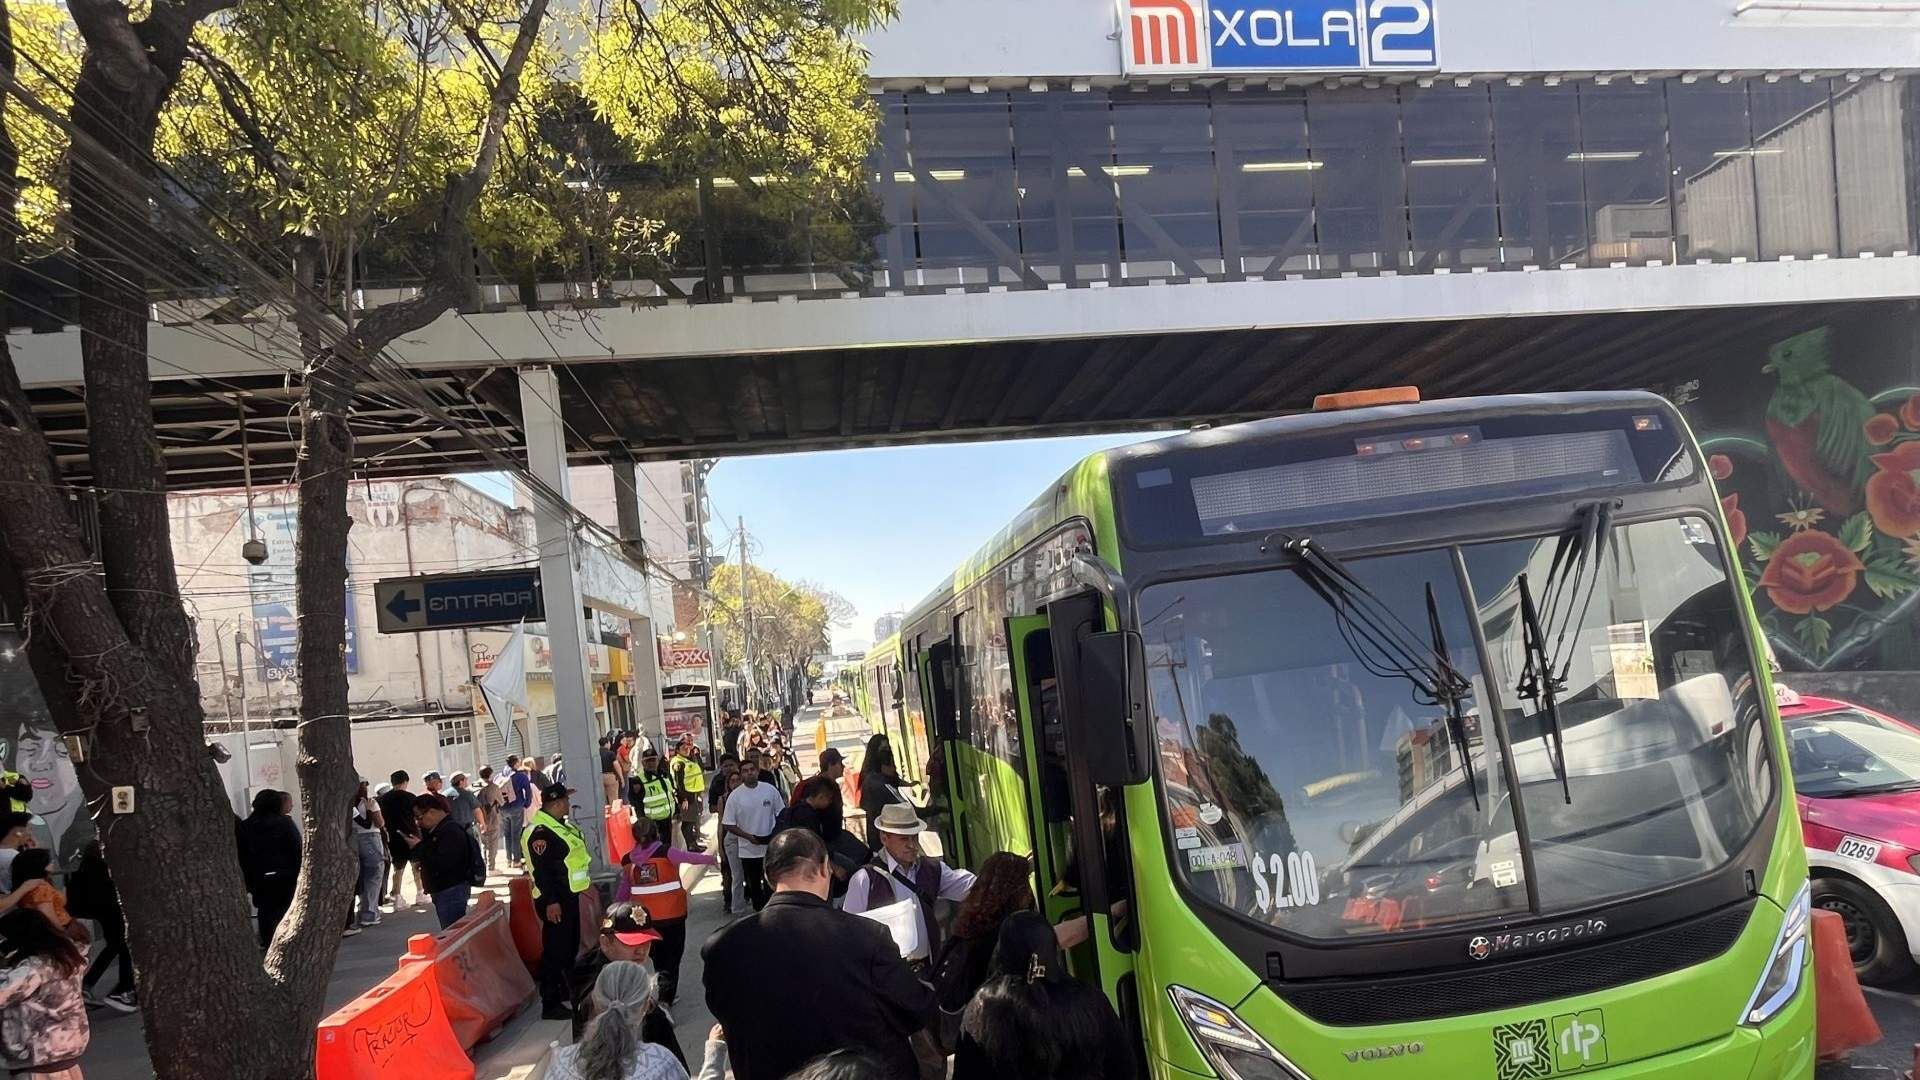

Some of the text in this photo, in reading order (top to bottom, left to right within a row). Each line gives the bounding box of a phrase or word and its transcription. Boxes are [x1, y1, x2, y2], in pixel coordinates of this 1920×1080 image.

[1213, 9, 1356, 47] XOLA
[1369, 0, 1433, 62] 2
[429, 587, 534, 611] ENTRADA
[1839, 839, 1876, 862] 0289
[1251, 850, 1320, 914] $2.00
[1494, 919, 1608, 951] Marcopolo
[1342, 1041, 1424, 1063] VOLVO
[1560, 1019, 1600, 1060] rtp
